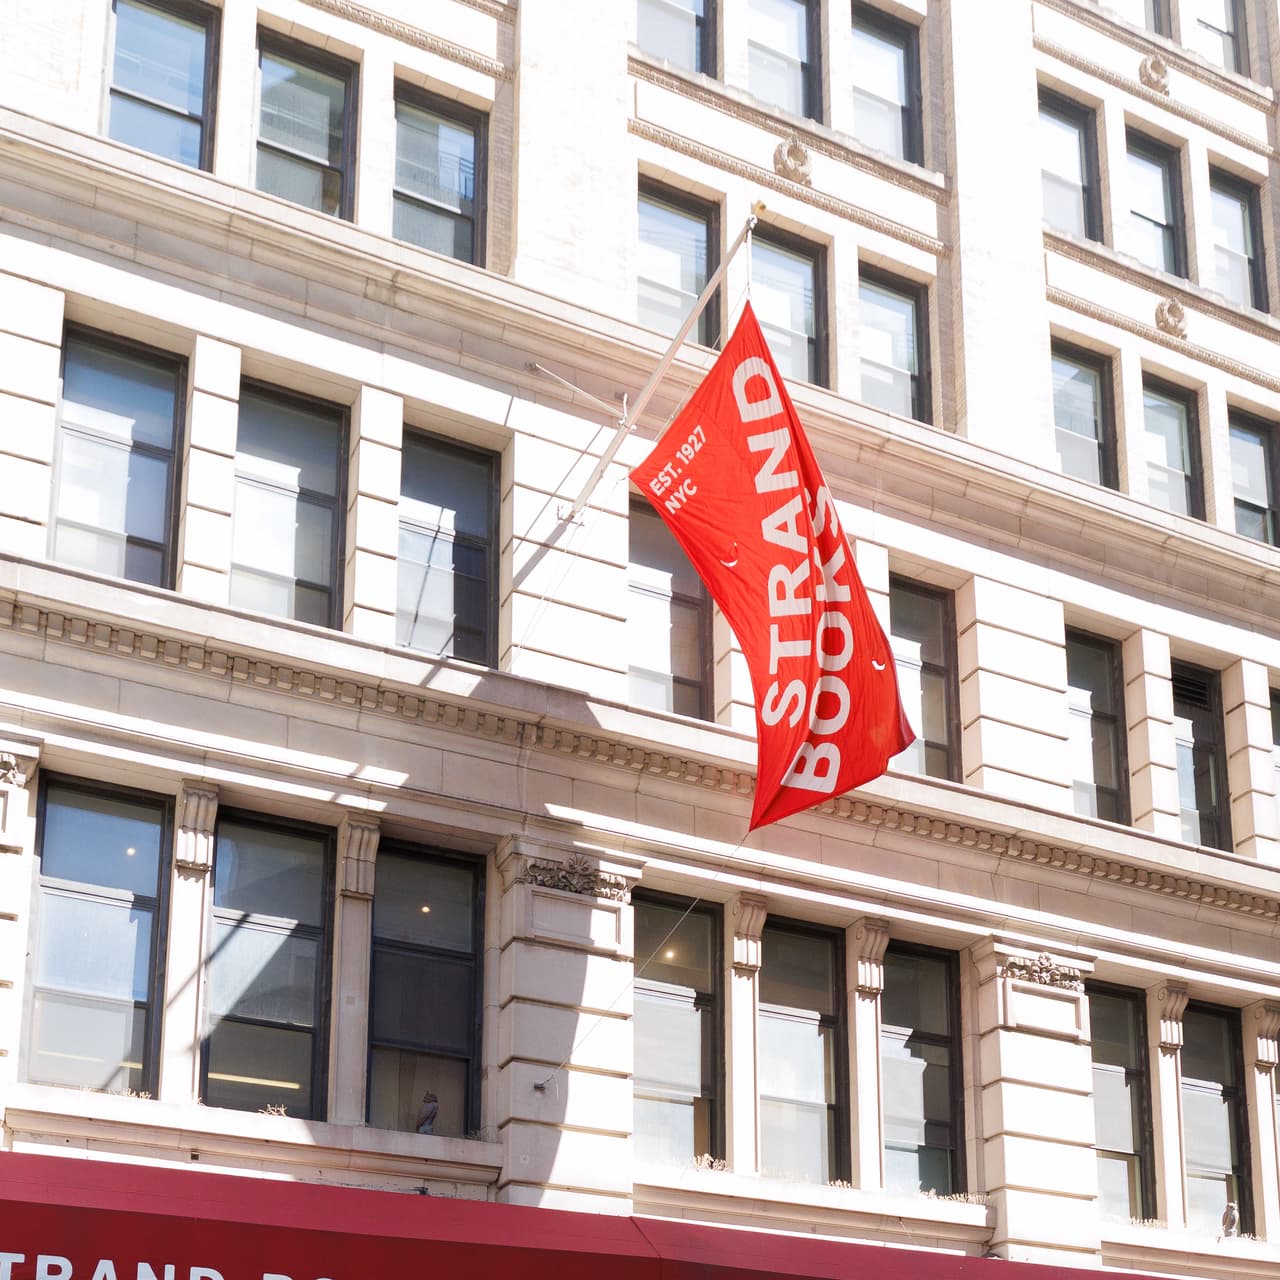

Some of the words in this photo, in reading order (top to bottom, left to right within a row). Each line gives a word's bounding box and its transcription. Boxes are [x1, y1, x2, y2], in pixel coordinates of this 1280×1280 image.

[650, 463, 685, 497] EST.
[675, 426, 707, 464] 1927
[664, 482, 698, 515] NYC
[732, 355, 812, 728] STRAND
[781, 482, 855, 794] BOOKS
